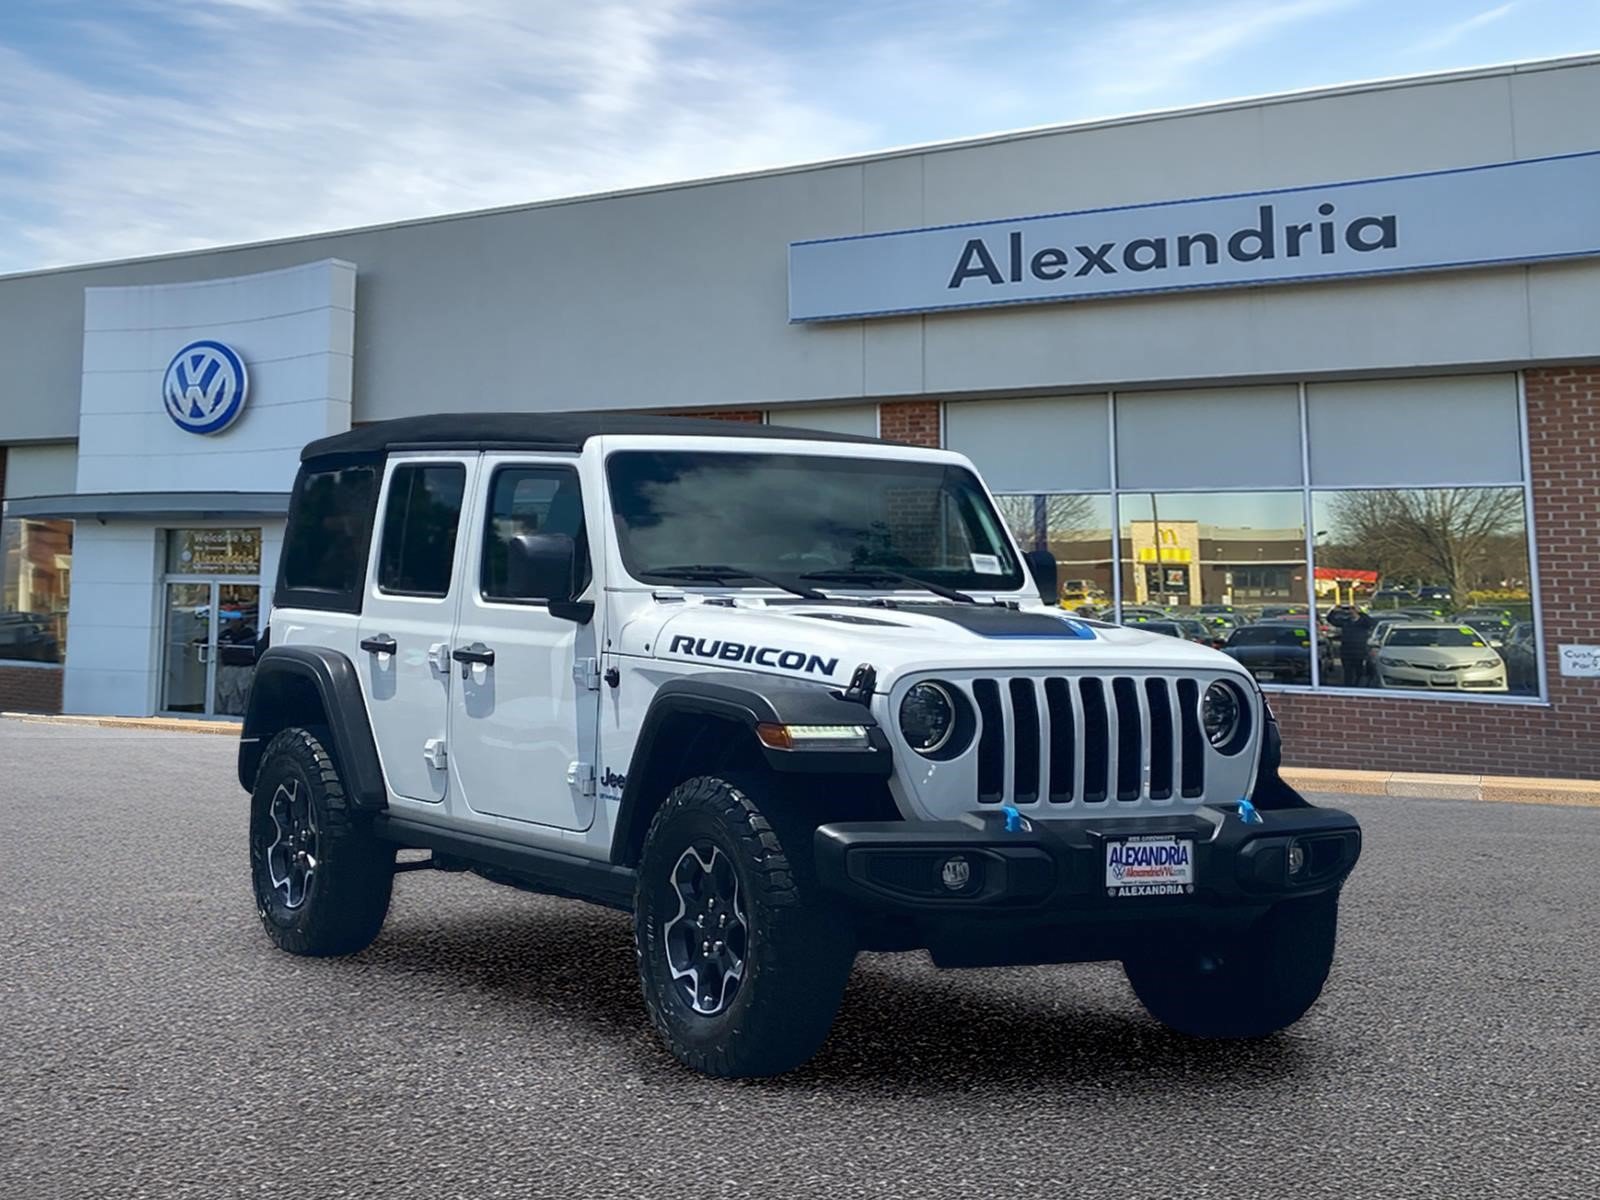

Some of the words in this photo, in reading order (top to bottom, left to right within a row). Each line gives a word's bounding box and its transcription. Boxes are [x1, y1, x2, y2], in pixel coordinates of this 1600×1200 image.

[948, 203, 1397, 289] Alexandria
[194, 532, 239, 543] Welcome
[242, 532, 252, 543] to
[670, 635, 840, 677] RUBICON
[601, 766, 626, 789] Jee
[1109, 846, 1188, 866] ALEXANDRIA
[1118, 885, 1184, 897] ALEXANDRIA
